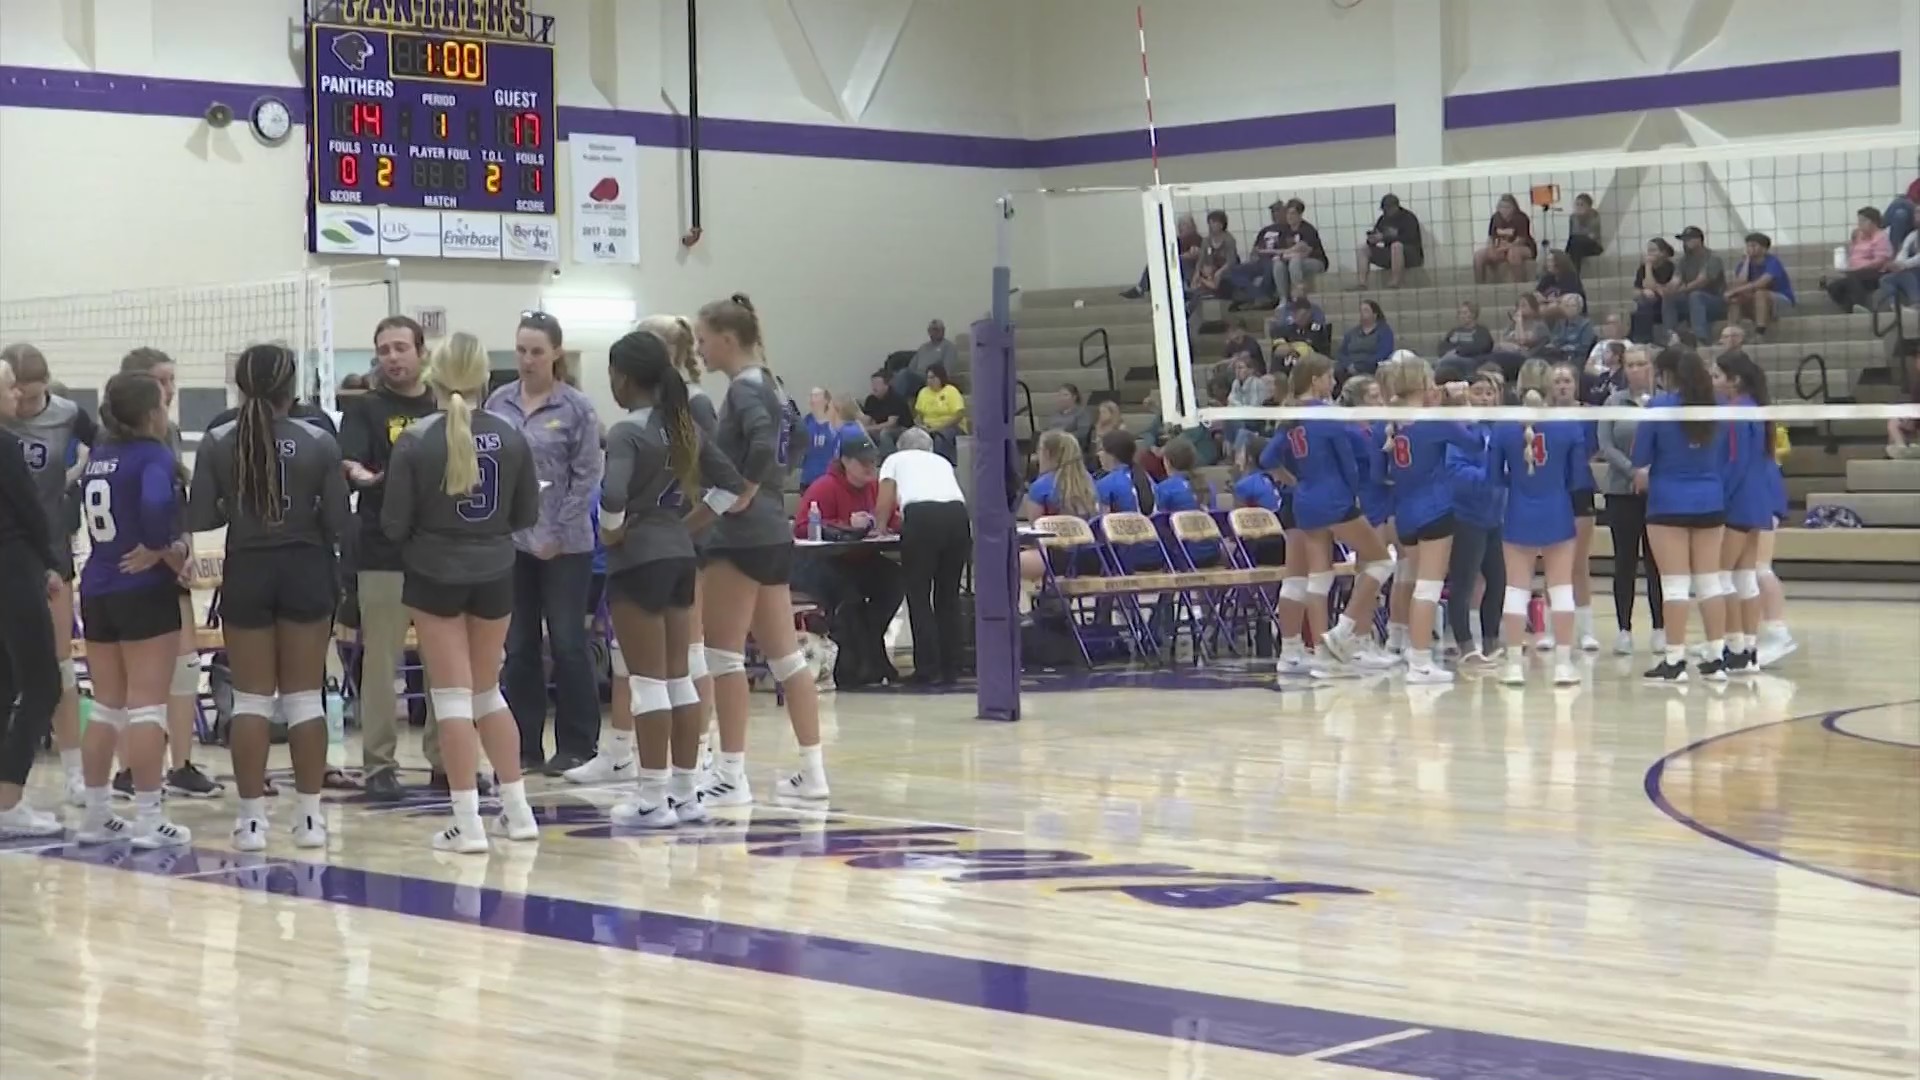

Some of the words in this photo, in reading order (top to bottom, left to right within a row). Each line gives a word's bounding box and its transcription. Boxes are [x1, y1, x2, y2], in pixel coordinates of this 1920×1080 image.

[428, 41, 481, 78] 1:00
[321, 75, 394, 98] PANTHERS
[422, 93, 456, 106] PERIOD
[494, 89, 537, 108] GUEST
[353, 102, 381, 136] 14
[440, 113, 447, 138] 1
[514, 113, 541, 146] 17
[329, 140, 361, 154] FOULS
[409, 146, 445, 158] PLAYER
[448, 149, 471, 160] FOUL
[516, 153, 545, 165] FOULS
[341, 155, 357, 185] 0
[378, 157, 392, 187] 2
[486, 164, 501, 193] 2
[330, 190, 362, 202] SCORE
[424, 196, 457, 208] MATCH
[516, 200, 545, 212] SCORE
[444, 230, 499, 247] Enerbase
[514, 225, 549, 240] Border
[422, 311, 442, 329] EXIT
[85, 479, 117, 542] 8
